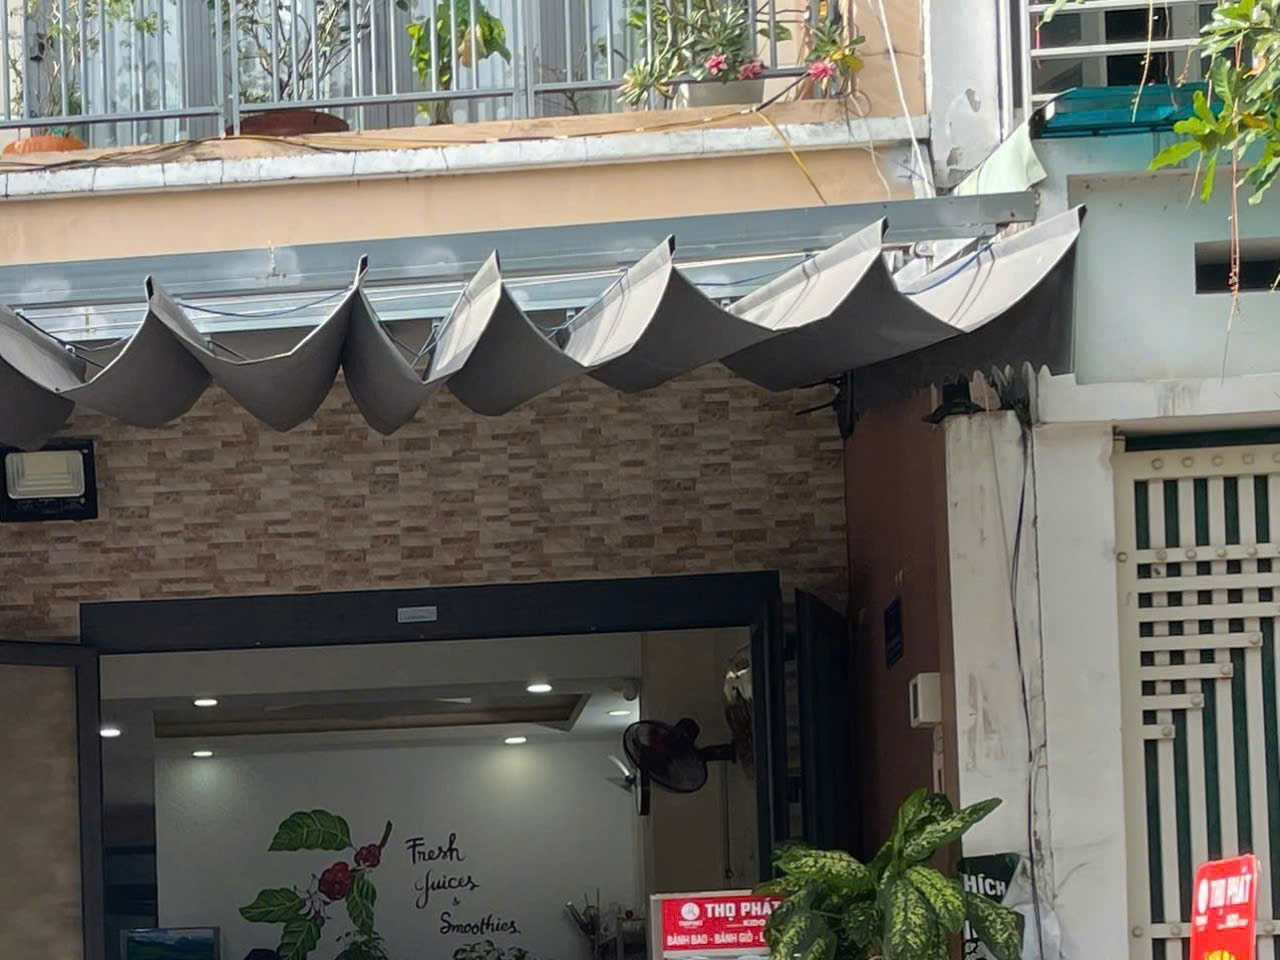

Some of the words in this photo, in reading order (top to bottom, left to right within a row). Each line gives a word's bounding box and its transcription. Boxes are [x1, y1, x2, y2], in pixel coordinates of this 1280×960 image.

[405, 833, 464, 864] Fresh
[440, 911, 521, 935] Smoothies
[705, 903, 736, 921] THỌ
